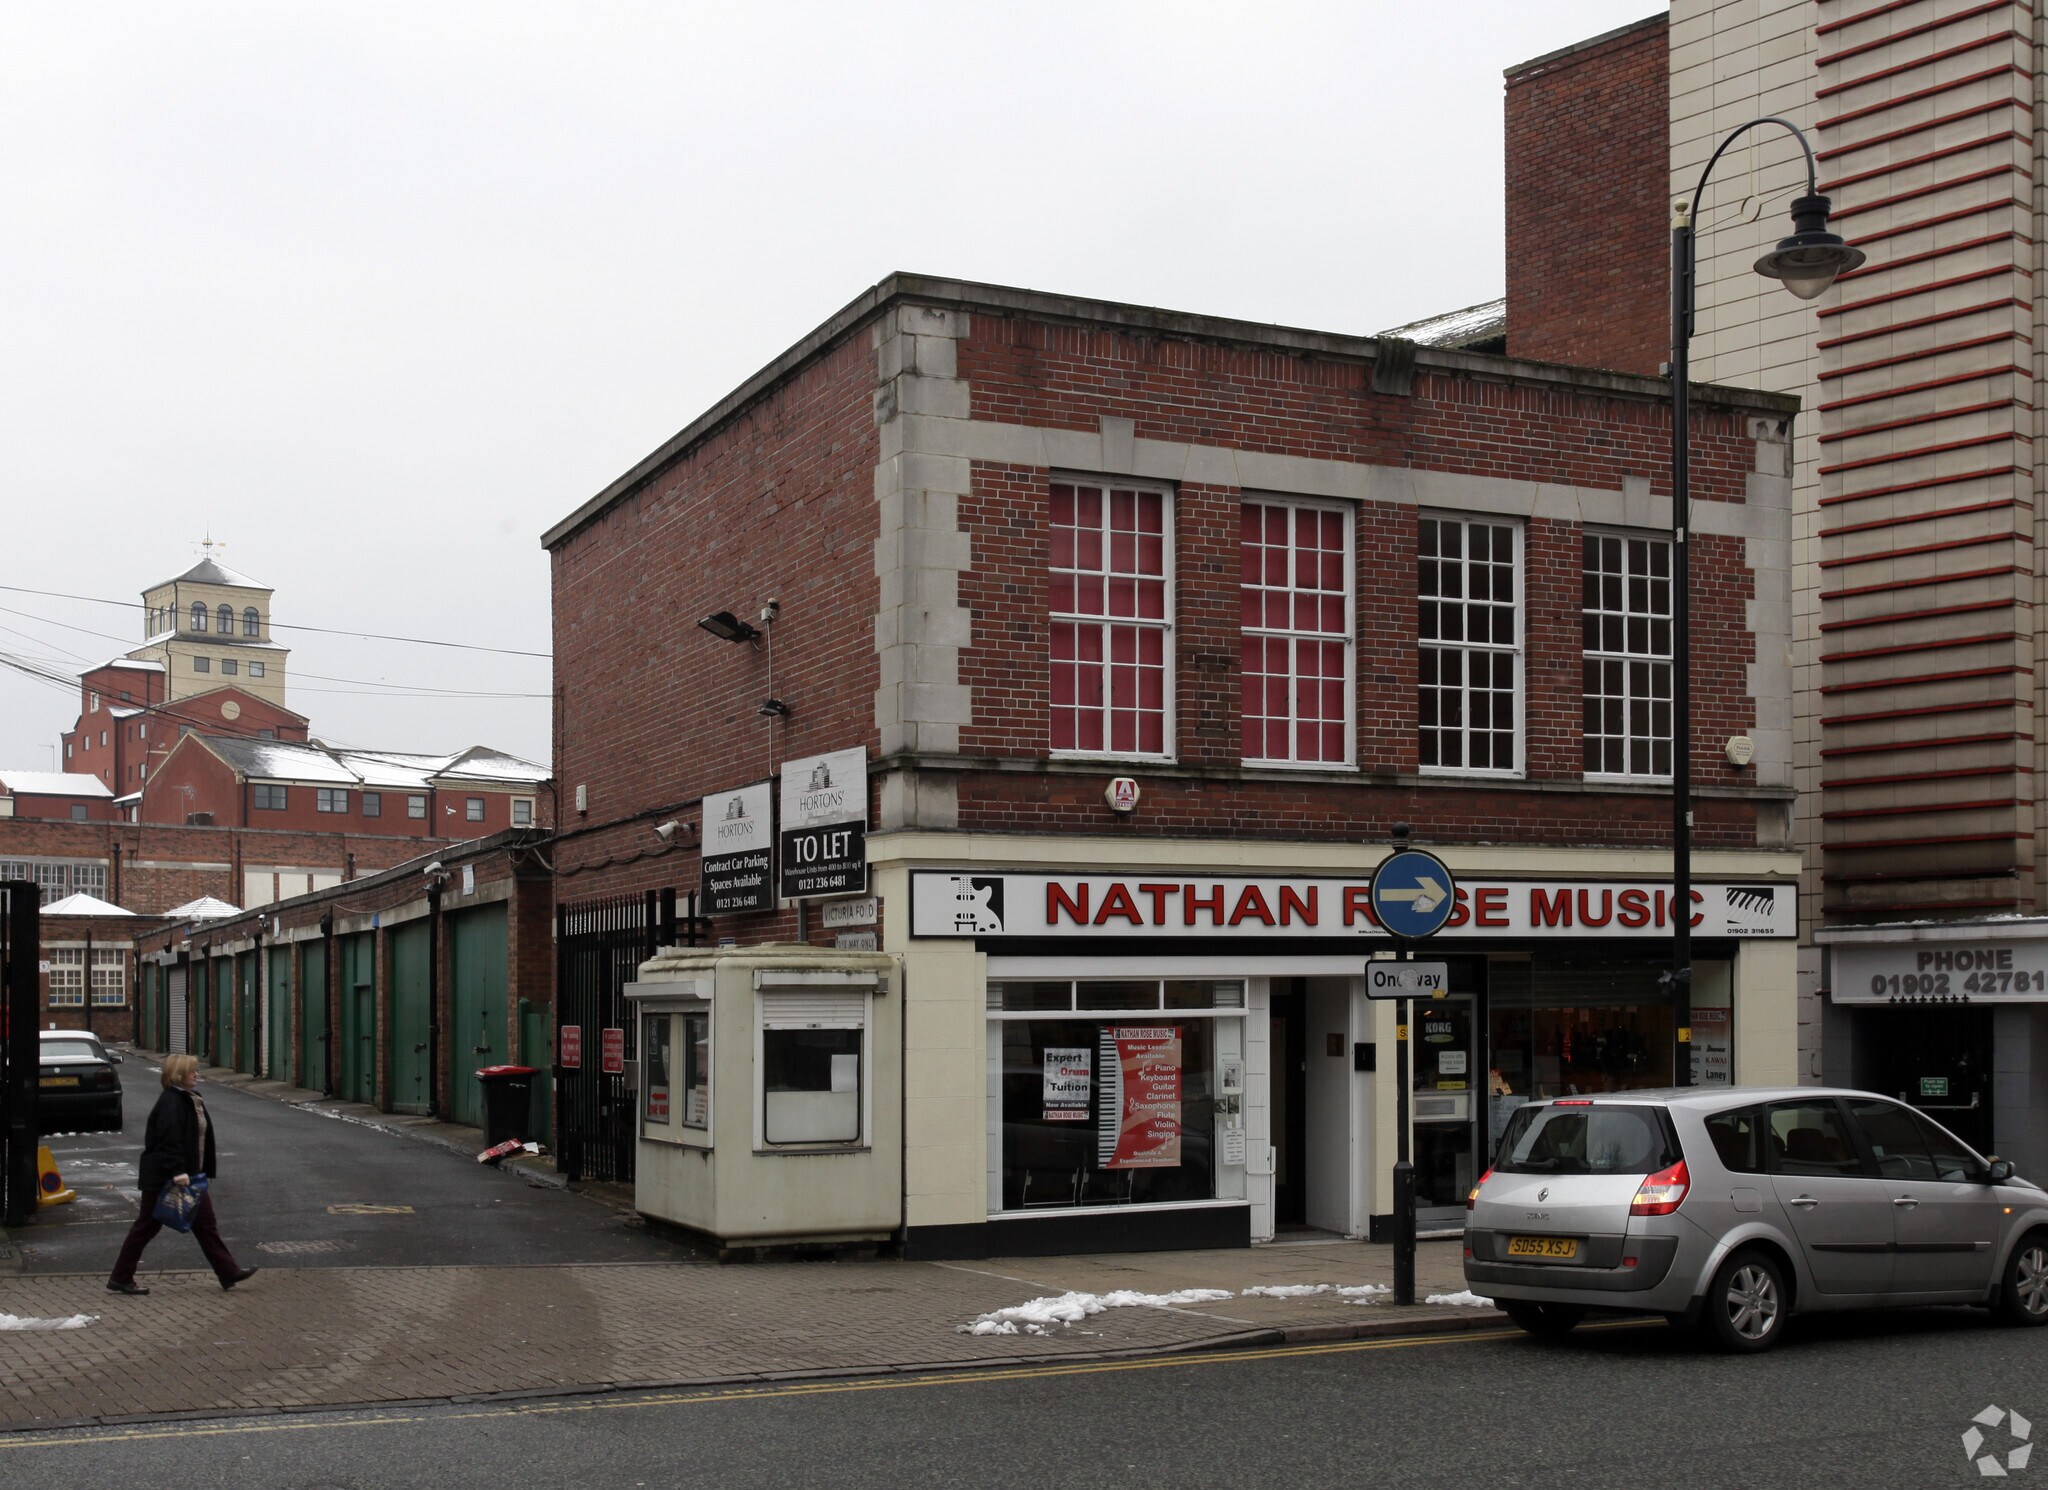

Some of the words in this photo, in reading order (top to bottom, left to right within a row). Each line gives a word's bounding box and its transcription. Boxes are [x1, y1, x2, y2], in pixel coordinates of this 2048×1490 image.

[793, 835, 818, 863] TO
[823, 830, 852, 860] LET
[704, 860, 731, 873] Contract
[732, 858, 743, 870] Car
[744, 854, 769, 870] Parking
[818, 864, 828, 872] from
[710, 878, 733, 894] Spaces
[733, 873, 762, 888] Available
[798, 878, 814, 891] 0121
[816, 876, 829, 888] 236
[829, 874, 846, 887] 6481
[716, 898, 731, 909] 0121
[732, 896, 743, 907] 236
[743, 895, 758, 906] 6481
[1046, 882, 1319, 926] NATHAN
[1342, 884, 1510, 928] RSE
[1530, 887, 1705, 928] MUSIC
[825, 905, 854, 921] VICTORIA
[856, 904, 874, 918] FOD
[860, 938, 875, 949] ONLY
[1917, 949, 2014, 972] PHONE
[1870, 972, 1951, 995] 01902
[1963, 970, 2048, 994] 42781
[1425, 1022, 1452, 1033] KORG
[1121, 1029, 1139, 1038] NATHAN
[1140, 1029, 1152, 1038] ROSE
[1152, 1029, 1168, 1038] MUSIC
[1046, 1053, 1082, 1063] Expert
[1705, 1057, 1727, 1065] KAWAI
[1060, 1067, 1090, 1076] Drum
[1155, 1064, 1176, 1072] Piano
[1140, 1074, 1176, 1082] Keyboard
[1706, 1069, 1727, 1081] Laney
[1050, 1081, 1088, 1091] Tuition
[1135, 1102, 1176, 1110] Saxophone
[1048, 1111, 1063, 1119] NATHAN
[1063, 1111, 1073, 1119] ROSE
[1073, 1111, 1084, 1119] MUSIC
[1147, 1130, 1176, 1138] Singing
[1514, 1238, 1544, 1254] SD55
[1546, 1239, 1572, 1255] XSJ
